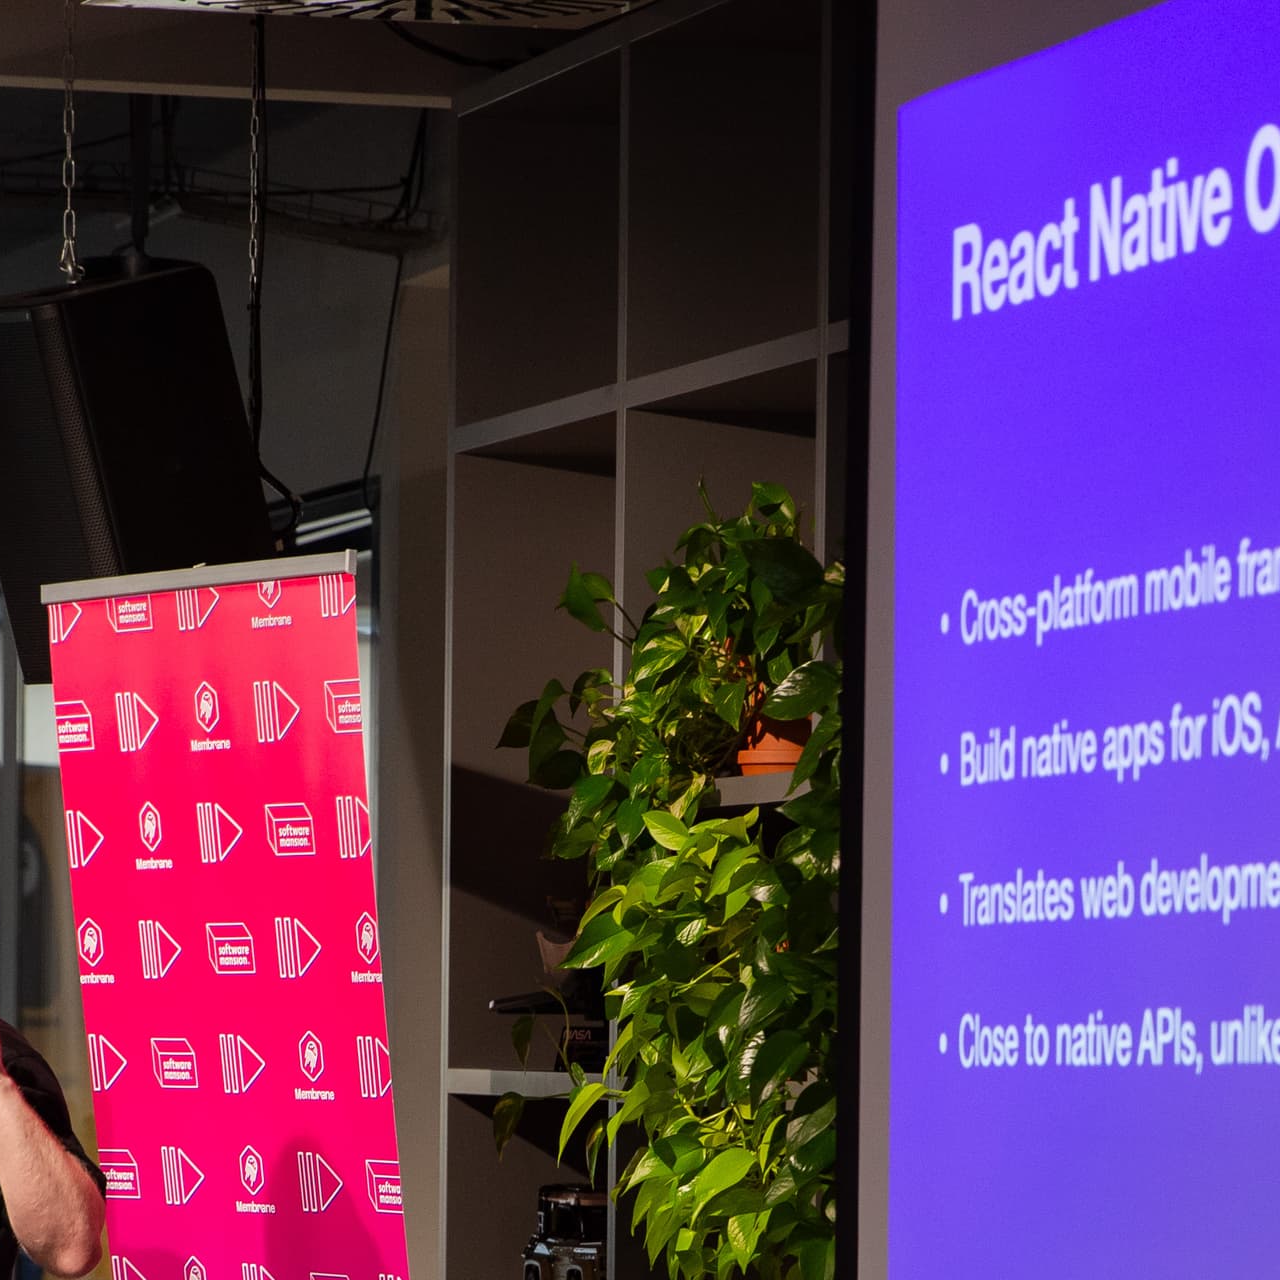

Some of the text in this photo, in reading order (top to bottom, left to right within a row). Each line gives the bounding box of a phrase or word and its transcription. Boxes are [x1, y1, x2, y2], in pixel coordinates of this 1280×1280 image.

[951, 197, 1080, 322] React
[1088, 156, 1234, 283] Native
[959, 567, 1140, 647] Cross-platform
[1143, 544, 1233, 615] mobile
[119, 601, 147, 614] software
[251, 615, 292, 629] Membrane
[58, 721, 89, 734] software
[190, 738, 231, 751] Membrane
[959, 725, 1017, 787] Build
[1020, 718, 1099, 779] native
[1101, 719, 1166, 783] apps
[1168, 702, 1208, 762] for
[1211, 690, 1271, 761] iOS,
[279, 824, 310, 837] software
[135, 857, 173, 870] Membrane
[957, 867, 1076, 927] Translates
[1079, 860, 1136, 920] web
[218, 943, 250, 956] software
[351, 970, 383, 983] Membra
[957, 1012, 1020, 1070] Close
[1023, 1013, 1051, 1067] to
[1055, 1009, 1134, 1068] native
[1135, 1006, 1204, 1075] APIs,
[163, 1058, 192, 1071] software
[294, 1088, 335, 1101] Membrane
[235, 1200, 276, 1214] Membrane
